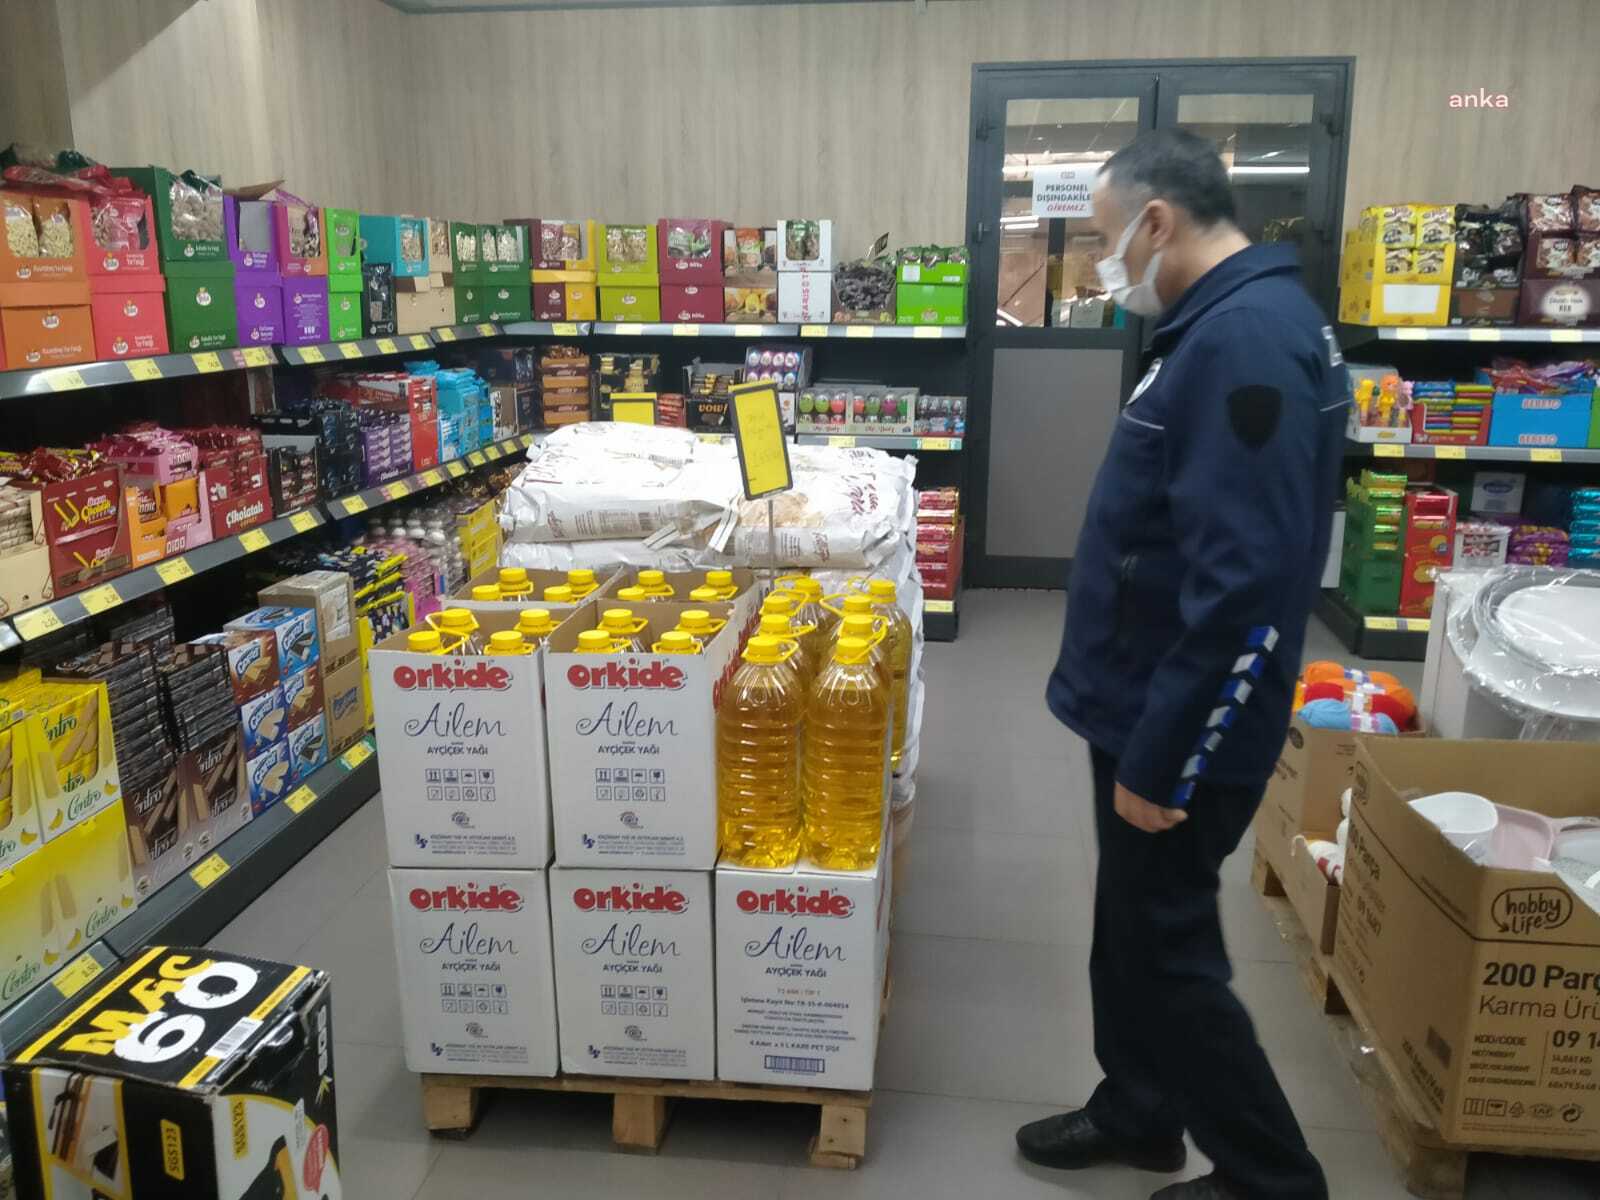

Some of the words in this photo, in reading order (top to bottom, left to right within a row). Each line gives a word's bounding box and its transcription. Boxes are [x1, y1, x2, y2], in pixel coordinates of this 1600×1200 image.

[1046, 183, 1088, 192] PERSONEL
[1047, 203, 1086, 212] GİREMEZ
[393, 658, 512, 692] orkide
[567, 657, 686, 691] orkide
[404, 701, 507, 738] Ailem
[576, 701, 679, 737] Ailem
[427, 744, 465, 756] AYÇİÇEK
[466, 744, 489, 756] YAĞI
[598, 744, 636, 756] AYÇİÇEK
[637, 744, 660, 756] YAĞI
[68, 789, 102, 821] Centro
[409, 882, 523, 913] orkide
[573, 882, 688, 914] orkide
[736, 886, 854, 918] orkide
[1506, 892, 1562, 923] hobby
[86, 905, 118, 938] Centro
[1511, 915, 1544, 936] Life
[419, 922, 518, 955] Ailem
[581, 923, 681, 957] Ailem
[744, 926, 847, 962] Ailem
[2, 959, 41, 1001] Centro
[441, 962, 478, 973] AYÇİÇEK
[479, 962, 502, 973] YAĞI
[603, 962, 639, 974] AYÇİÇEK
[640, 962, 663, 974] YAĞI
[765, 966, 803, 979] AYÇİÇEK
[804, 967, 827, 979] YAĞI
[1482, 962, 1536, 988] 200
[114, 961, 259, 1063] 60
[1478, 995, 1557, 1018] Karma
[1553, 1029, 1581, 1049] 09
